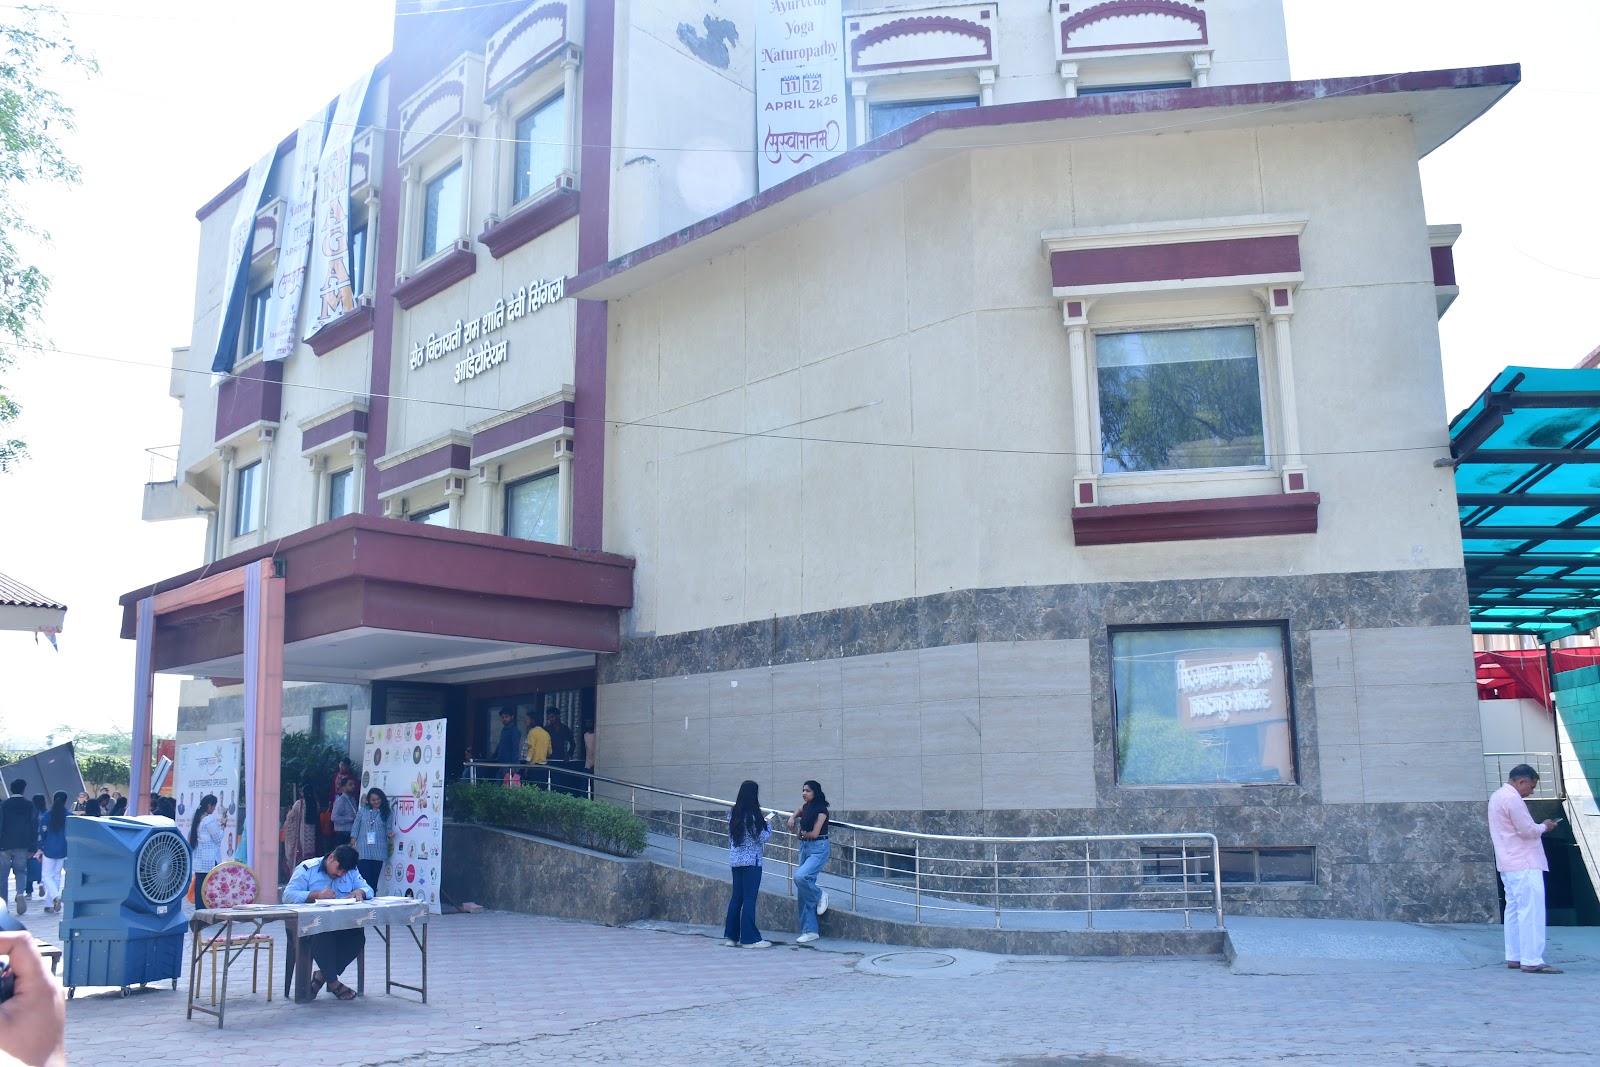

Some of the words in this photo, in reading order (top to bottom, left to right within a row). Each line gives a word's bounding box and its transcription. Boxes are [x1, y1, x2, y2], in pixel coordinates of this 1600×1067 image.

[785, 20, 814, 40] Yoga
[761, 40, 838, 64] Naturopathy
[785, 81, 797, 92] 11
[805, 80, 820, 91] 12
[764, 99, 805, 112] APRIL
[409, 342, 425, 370] सेठ
[425, 319, 463, 362] विलायती
[463, 317, 481, 344] राम
[506, 286, 527, 321] देवी
[528, 275, 567, 312] सिंगला
